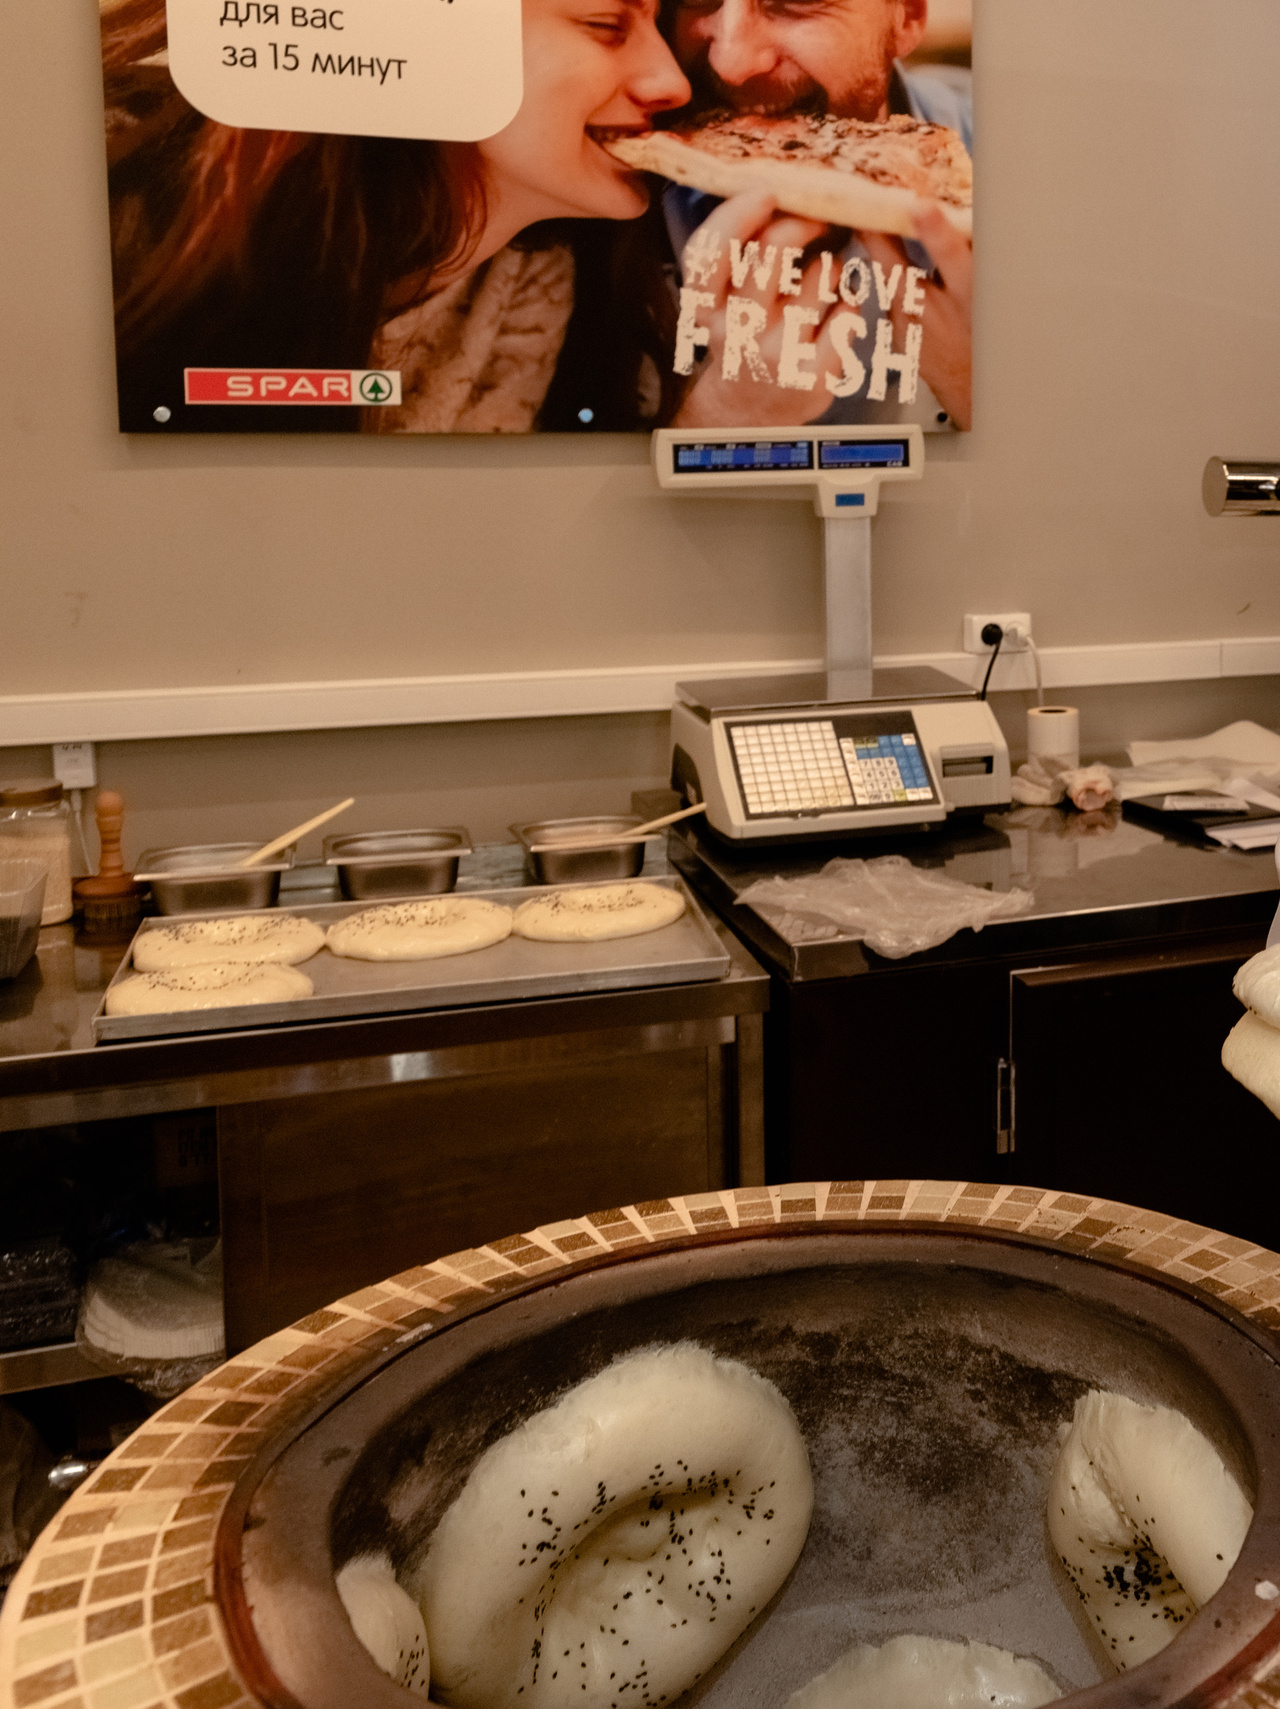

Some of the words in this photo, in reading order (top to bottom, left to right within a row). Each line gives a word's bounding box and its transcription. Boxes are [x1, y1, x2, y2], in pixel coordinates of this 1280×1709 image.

[219, 0, 279, 28] для
[291, 6, 344, 31] вас
[222, 45, 257, 69] за
[268, 42, 299, 71] 15
[311, 52, 408, 86] минут
[818, 250, 928, 317] LOVE
[672, 286, 923, 405] FRESH
[226, 375, 349, 398] SPAR
